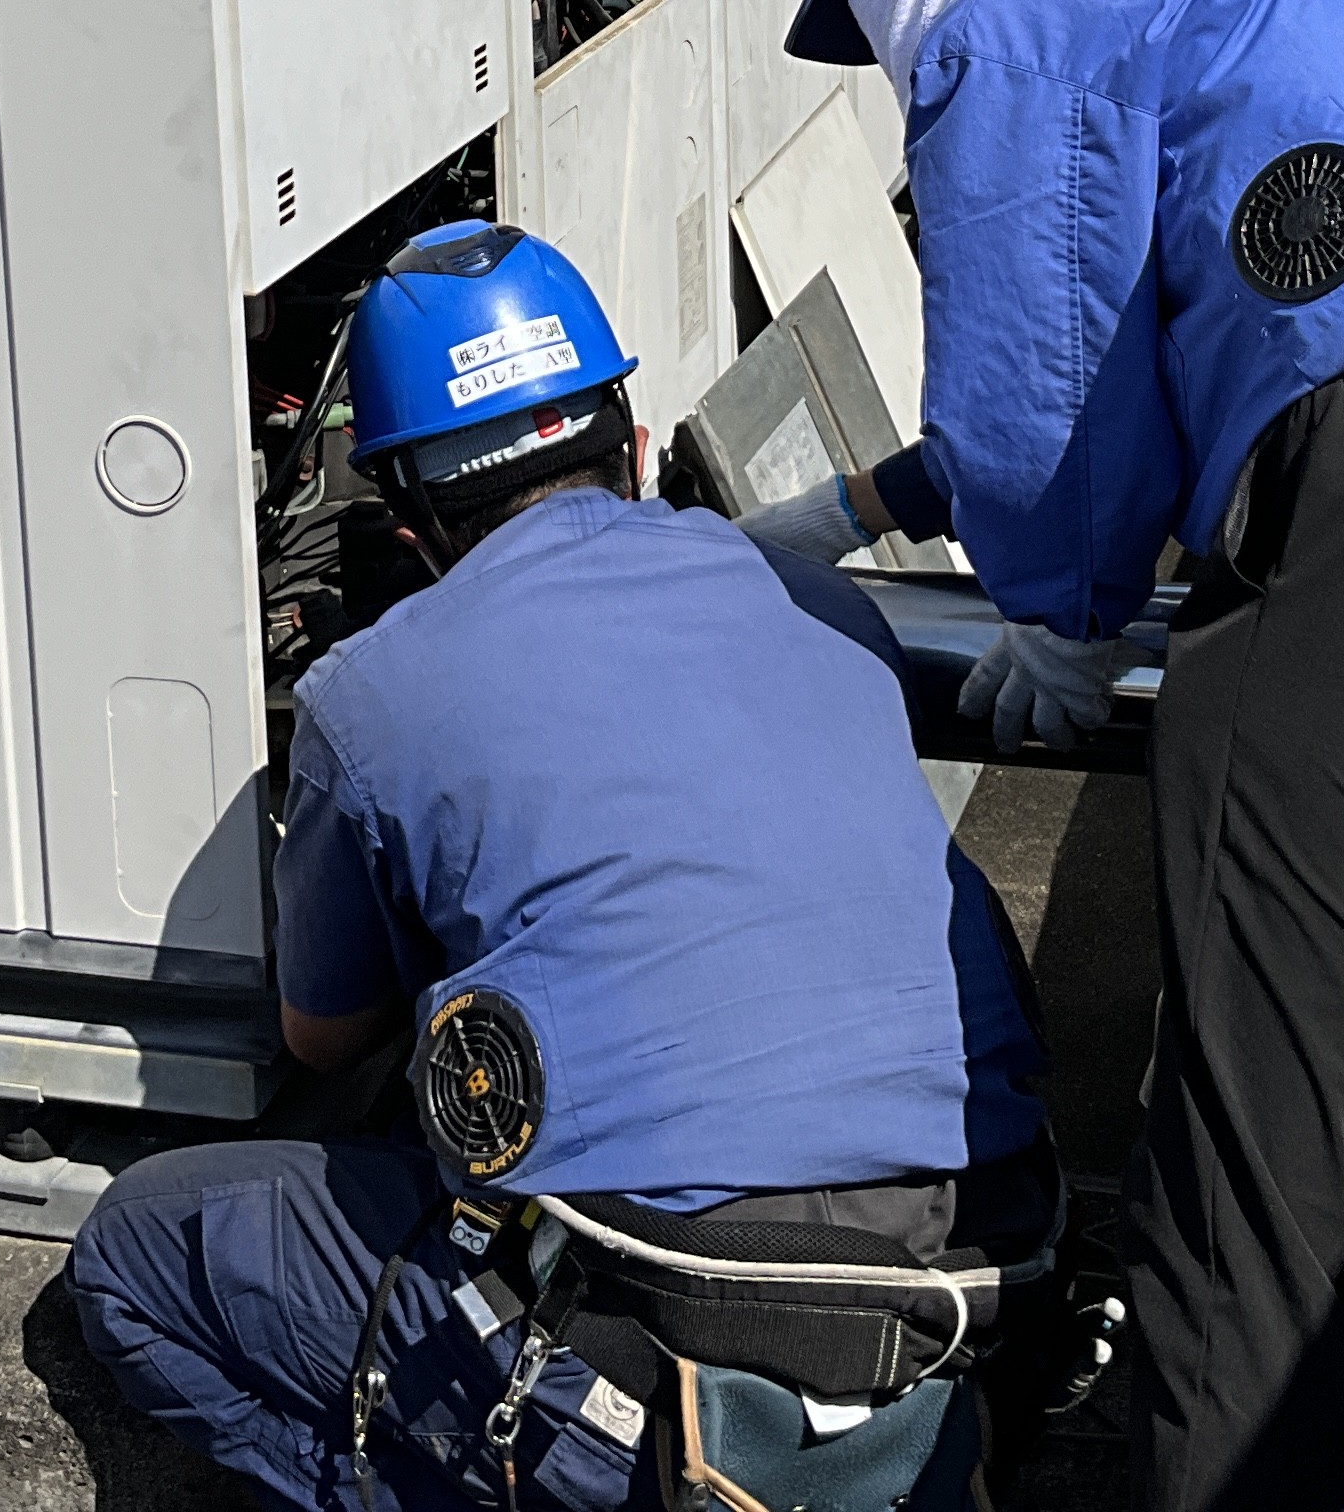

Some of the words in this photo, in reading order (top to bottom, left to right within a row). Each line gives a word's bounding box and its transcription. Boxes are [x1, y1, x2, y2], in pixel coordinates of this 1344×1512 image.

[456, 320, 561, 368] ㈱ライ空調
[457, 362, 526, 397] もりした
[545, 347, 574, 369] A型
[469, 1121, 533, 1175] BURTLE
